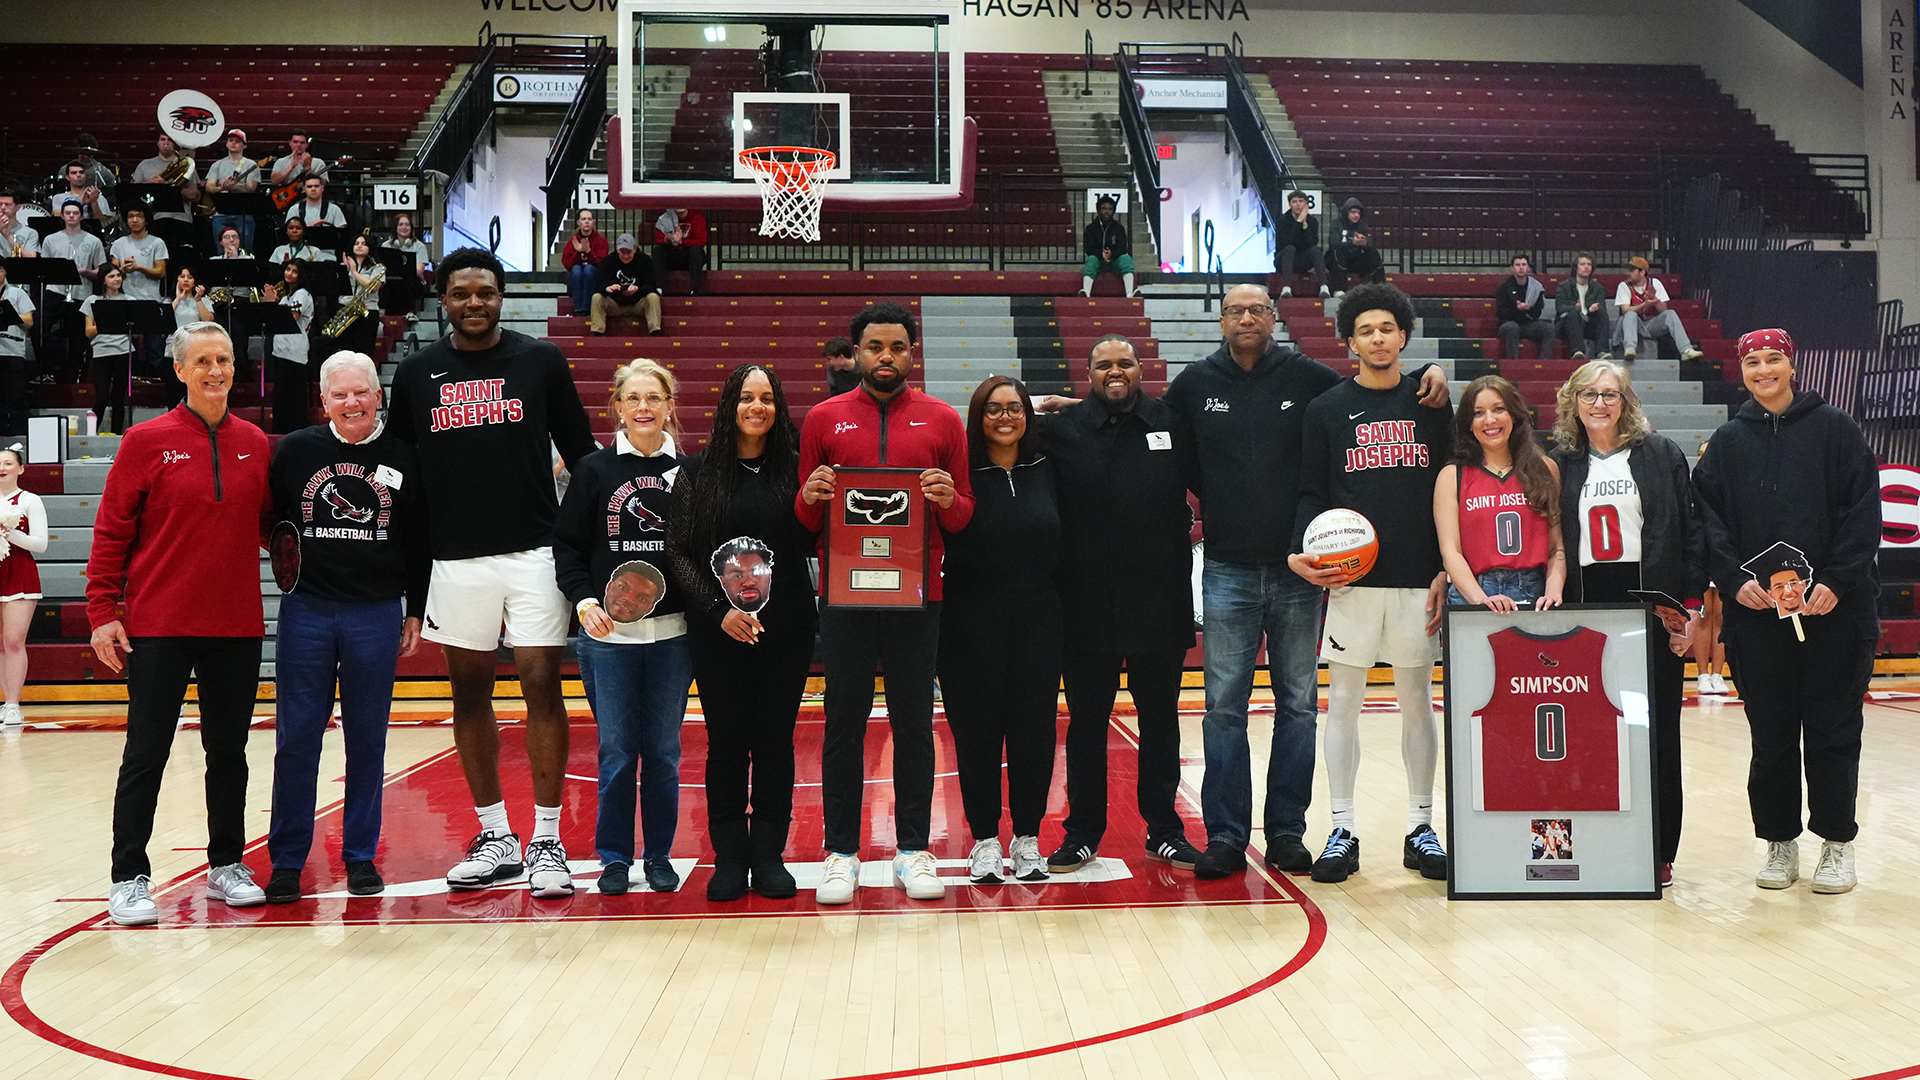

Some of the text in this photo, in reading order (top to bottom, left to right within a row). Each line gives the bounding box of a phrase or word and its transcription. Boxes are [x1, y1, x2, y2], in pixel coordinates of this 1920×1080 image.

[963, 0, 1079, 18] HAGAN
[1142, 0, 1250, 21] ARENA
[1889, 9, 1907, 120] ARENA
[1148, 89, 1225, 98] Anchor Mechanical
[171, 119, 209, 135] SJU
[1157, 145, 1174, 159] EXIT
[380, 189, 411, 205] 116
[440, 378, 505, 406] SAINT
[430, 398, 524, 433] JOSEPH'S
[1355, 420, 1416, 446] SAINT
[1345, 443, 1430, 473] JOSEPH'S
[303, 466, 334, 499] HAWK
[335, 462, 366, 479] WILL
[301, 501, 314, 523] THE
[607, 476, 664, 537] THE HAWK WILL
[1465, 495, 1496, 512] SAINT
[315, 527, 374, 541] BASKETBALL
[1495, 511, 1522, 556] 0
[1588, 504, 1624, 561] 0
[1510, 675, 1589, 694] SIMPSON
[1535, 702, 1567, 762] 0
